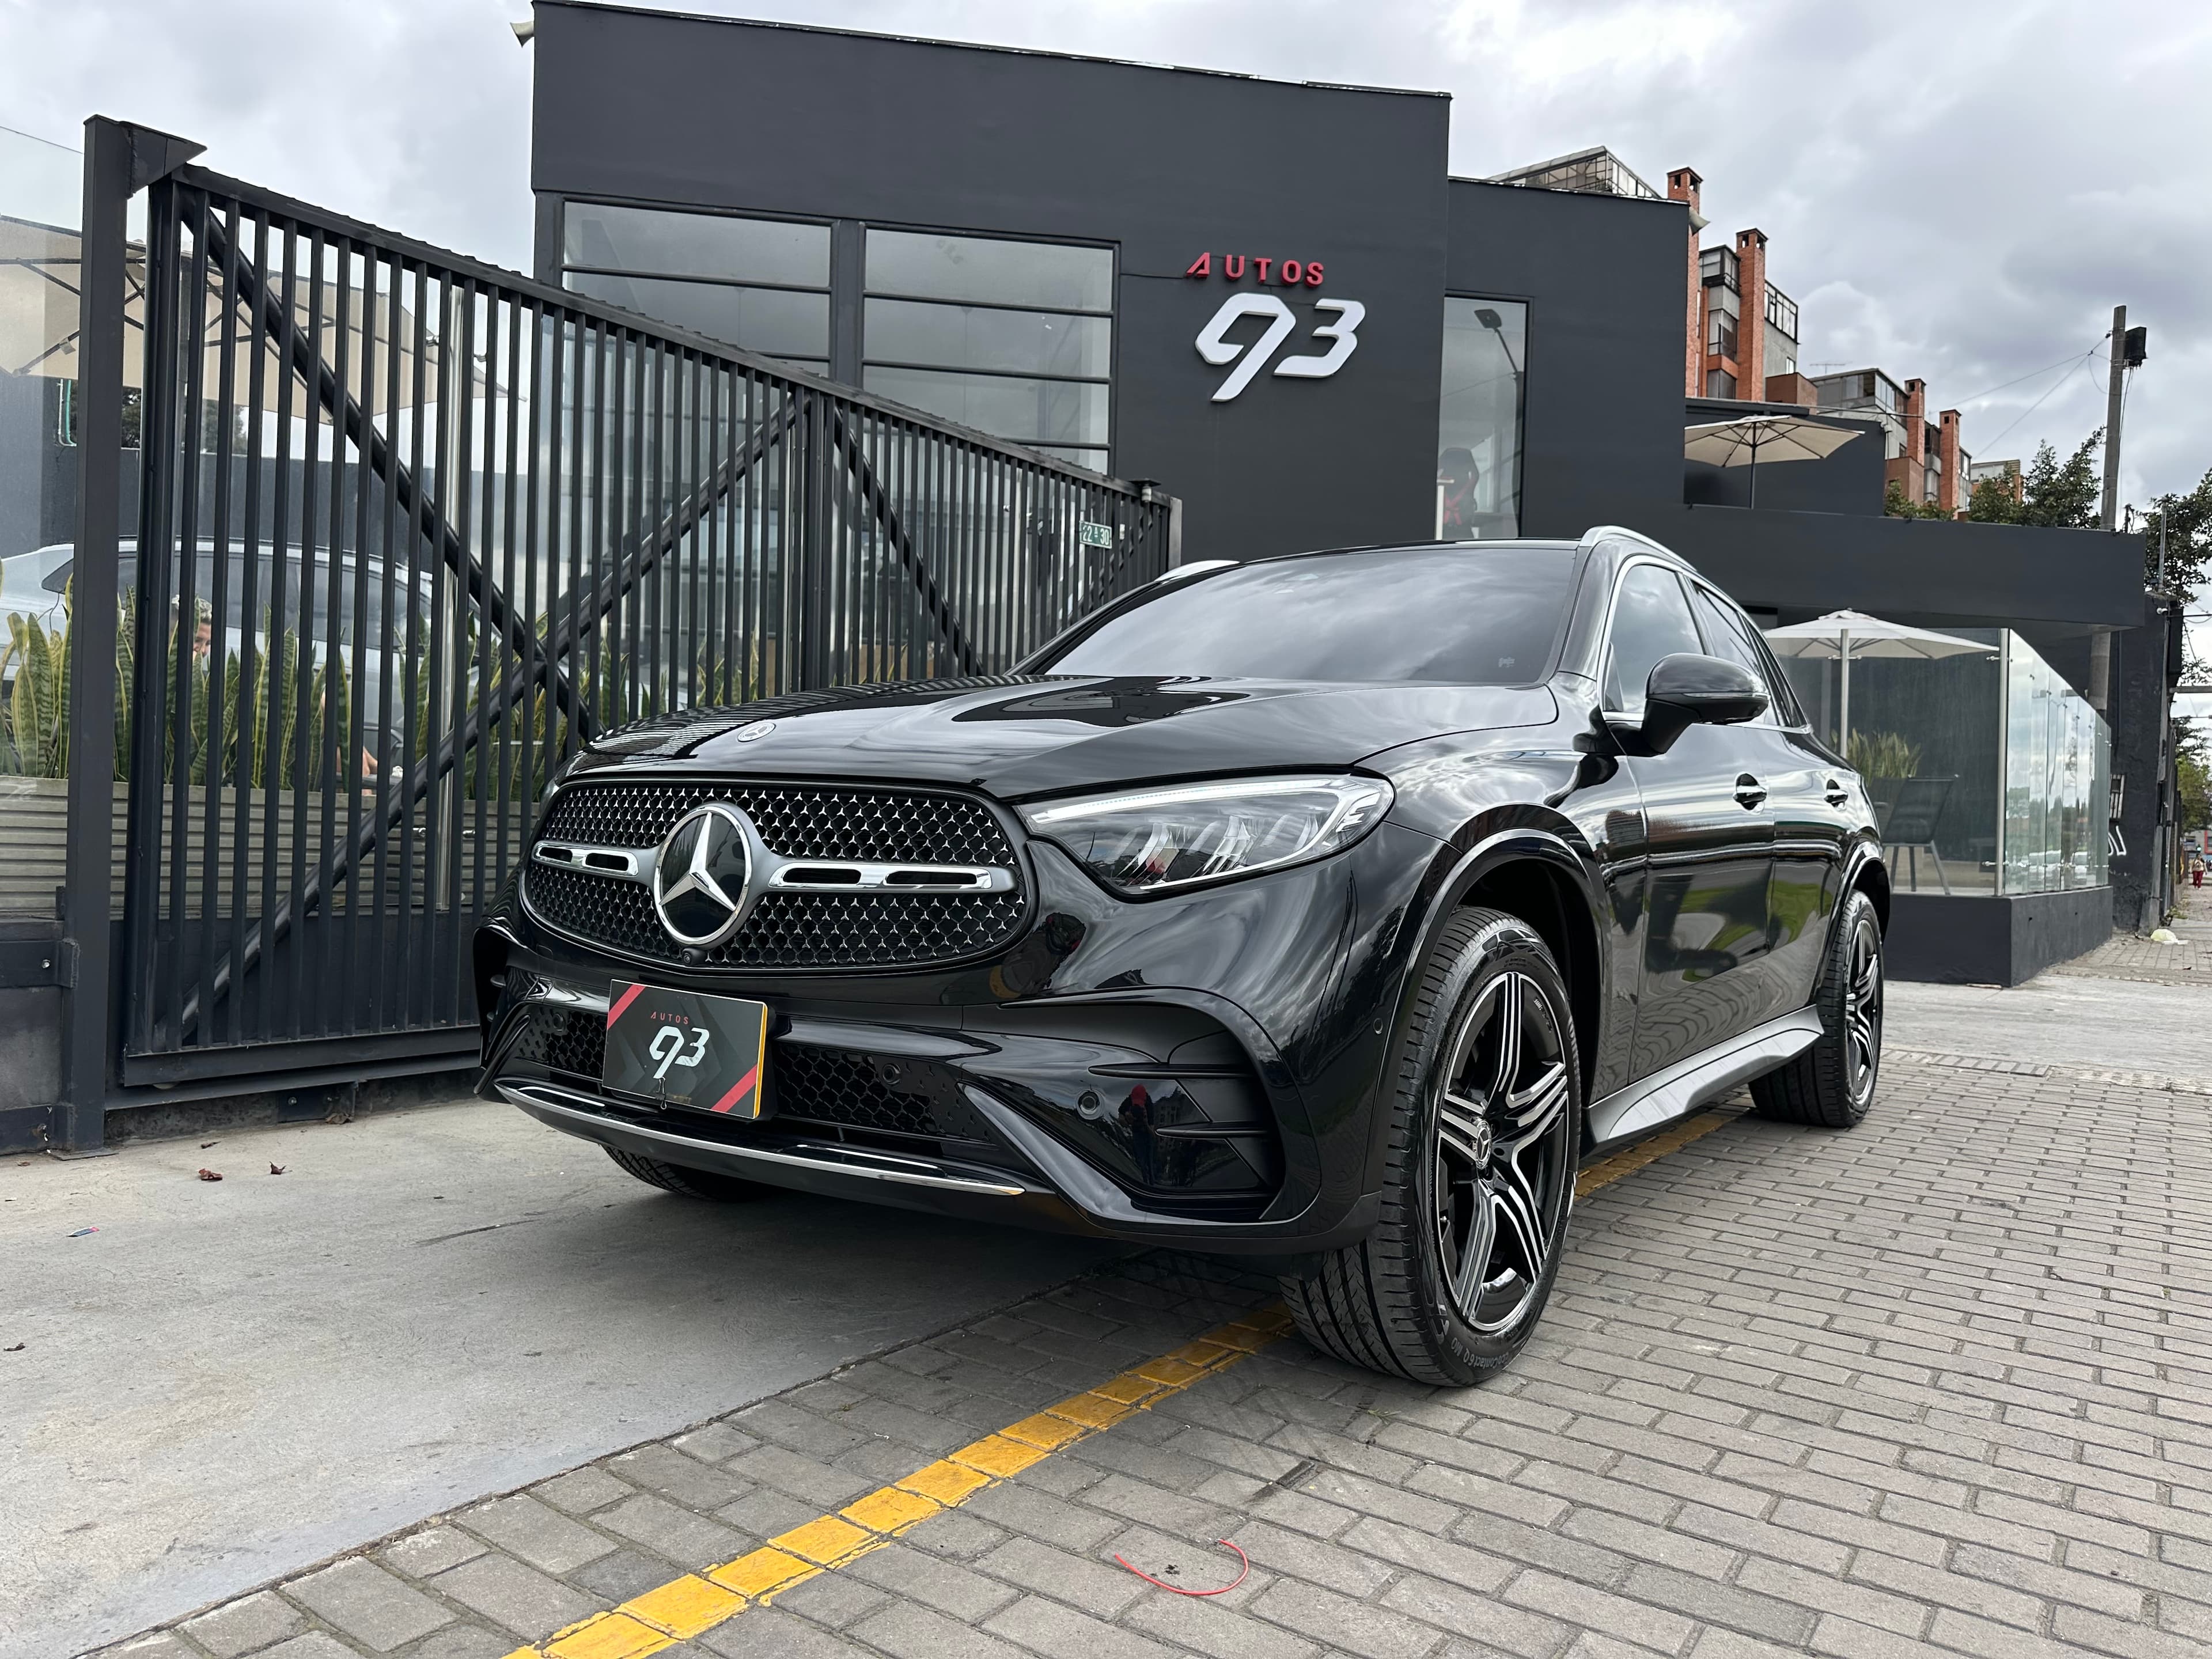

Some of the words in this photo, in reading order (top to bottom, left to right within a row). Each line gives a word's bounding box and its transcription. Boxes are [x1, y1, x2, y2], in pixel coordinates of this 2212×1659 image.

[1185, 252, 1324, 287] AUTOS
[1195, 292, 1366, 402] 93
[650, 1011, 690, 1025] AUTOS
[649, 1025, 710, 1079] 93
